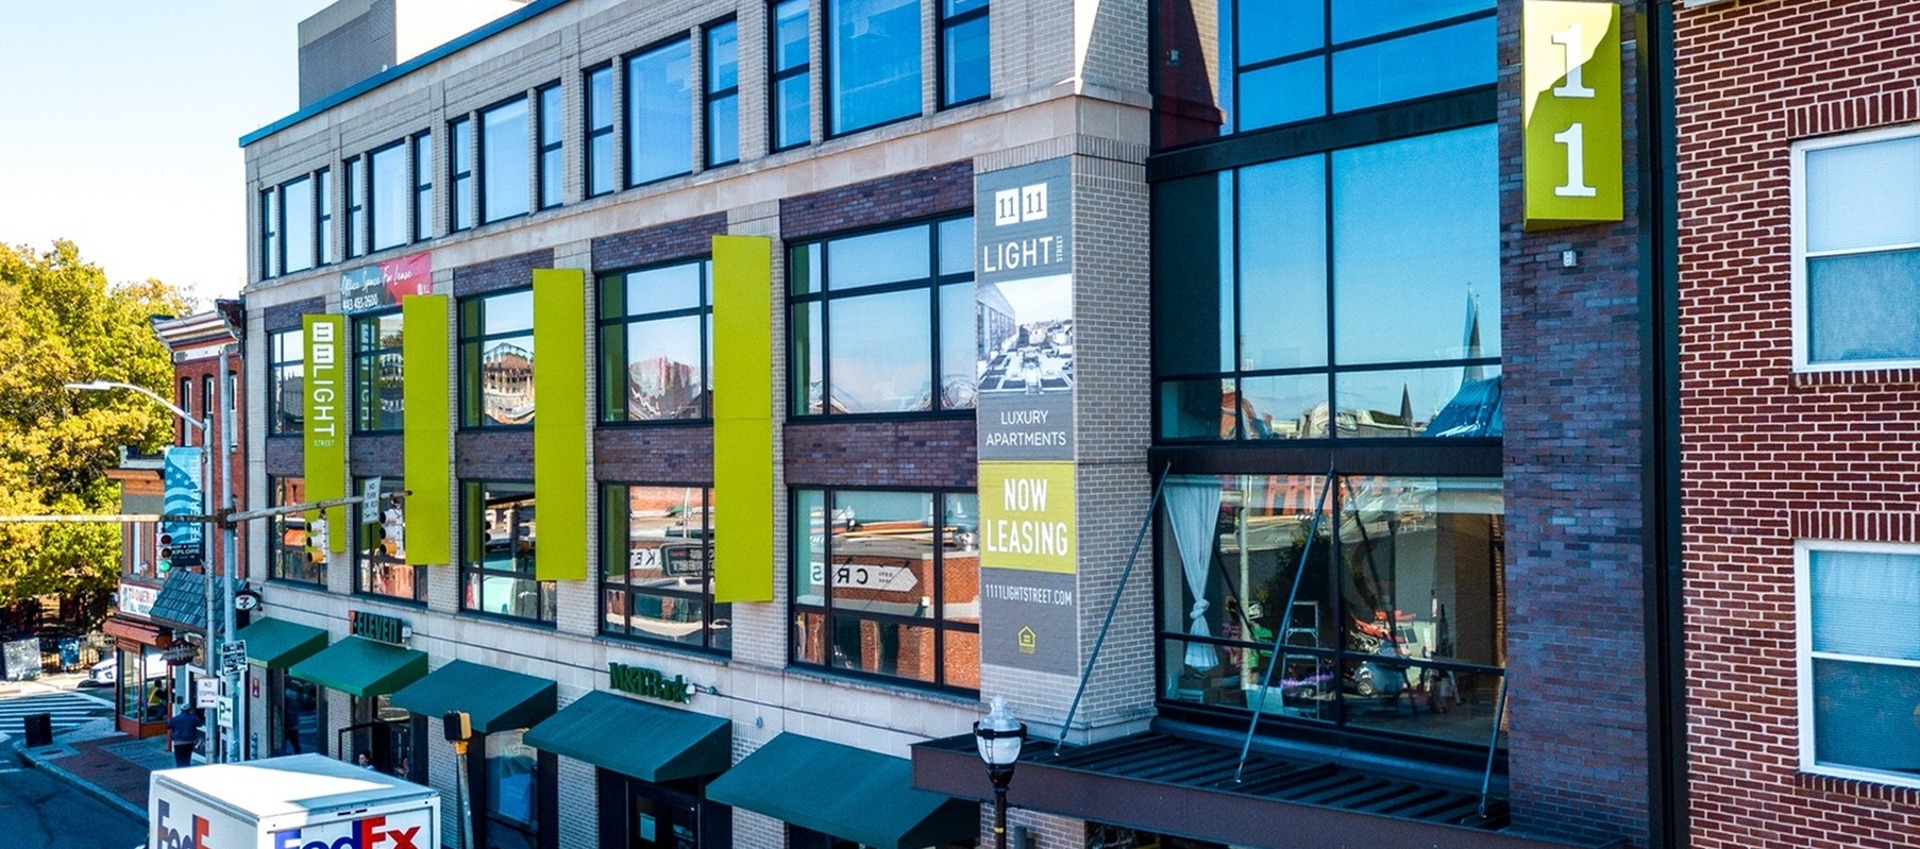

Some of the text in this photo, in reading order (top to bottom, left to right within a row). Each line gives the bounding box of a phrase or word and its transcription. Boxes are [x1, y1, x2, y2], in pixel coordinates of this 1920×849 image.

[999, 191, 1043, 219] 11 11
[984, 236, 1053, 273] LIGHT
[313, 365, 335, 437] LIGHT
[1001, 410, 1049, 425] LUXURY
[985, 432, 1067, 447] APARTMENTS
[1004, 478, 1048, 512] NOW
[987, 519, 1069, 557] LEASING
[985, 584, 1073, 606] 1111LIGHTSTREET.COM
